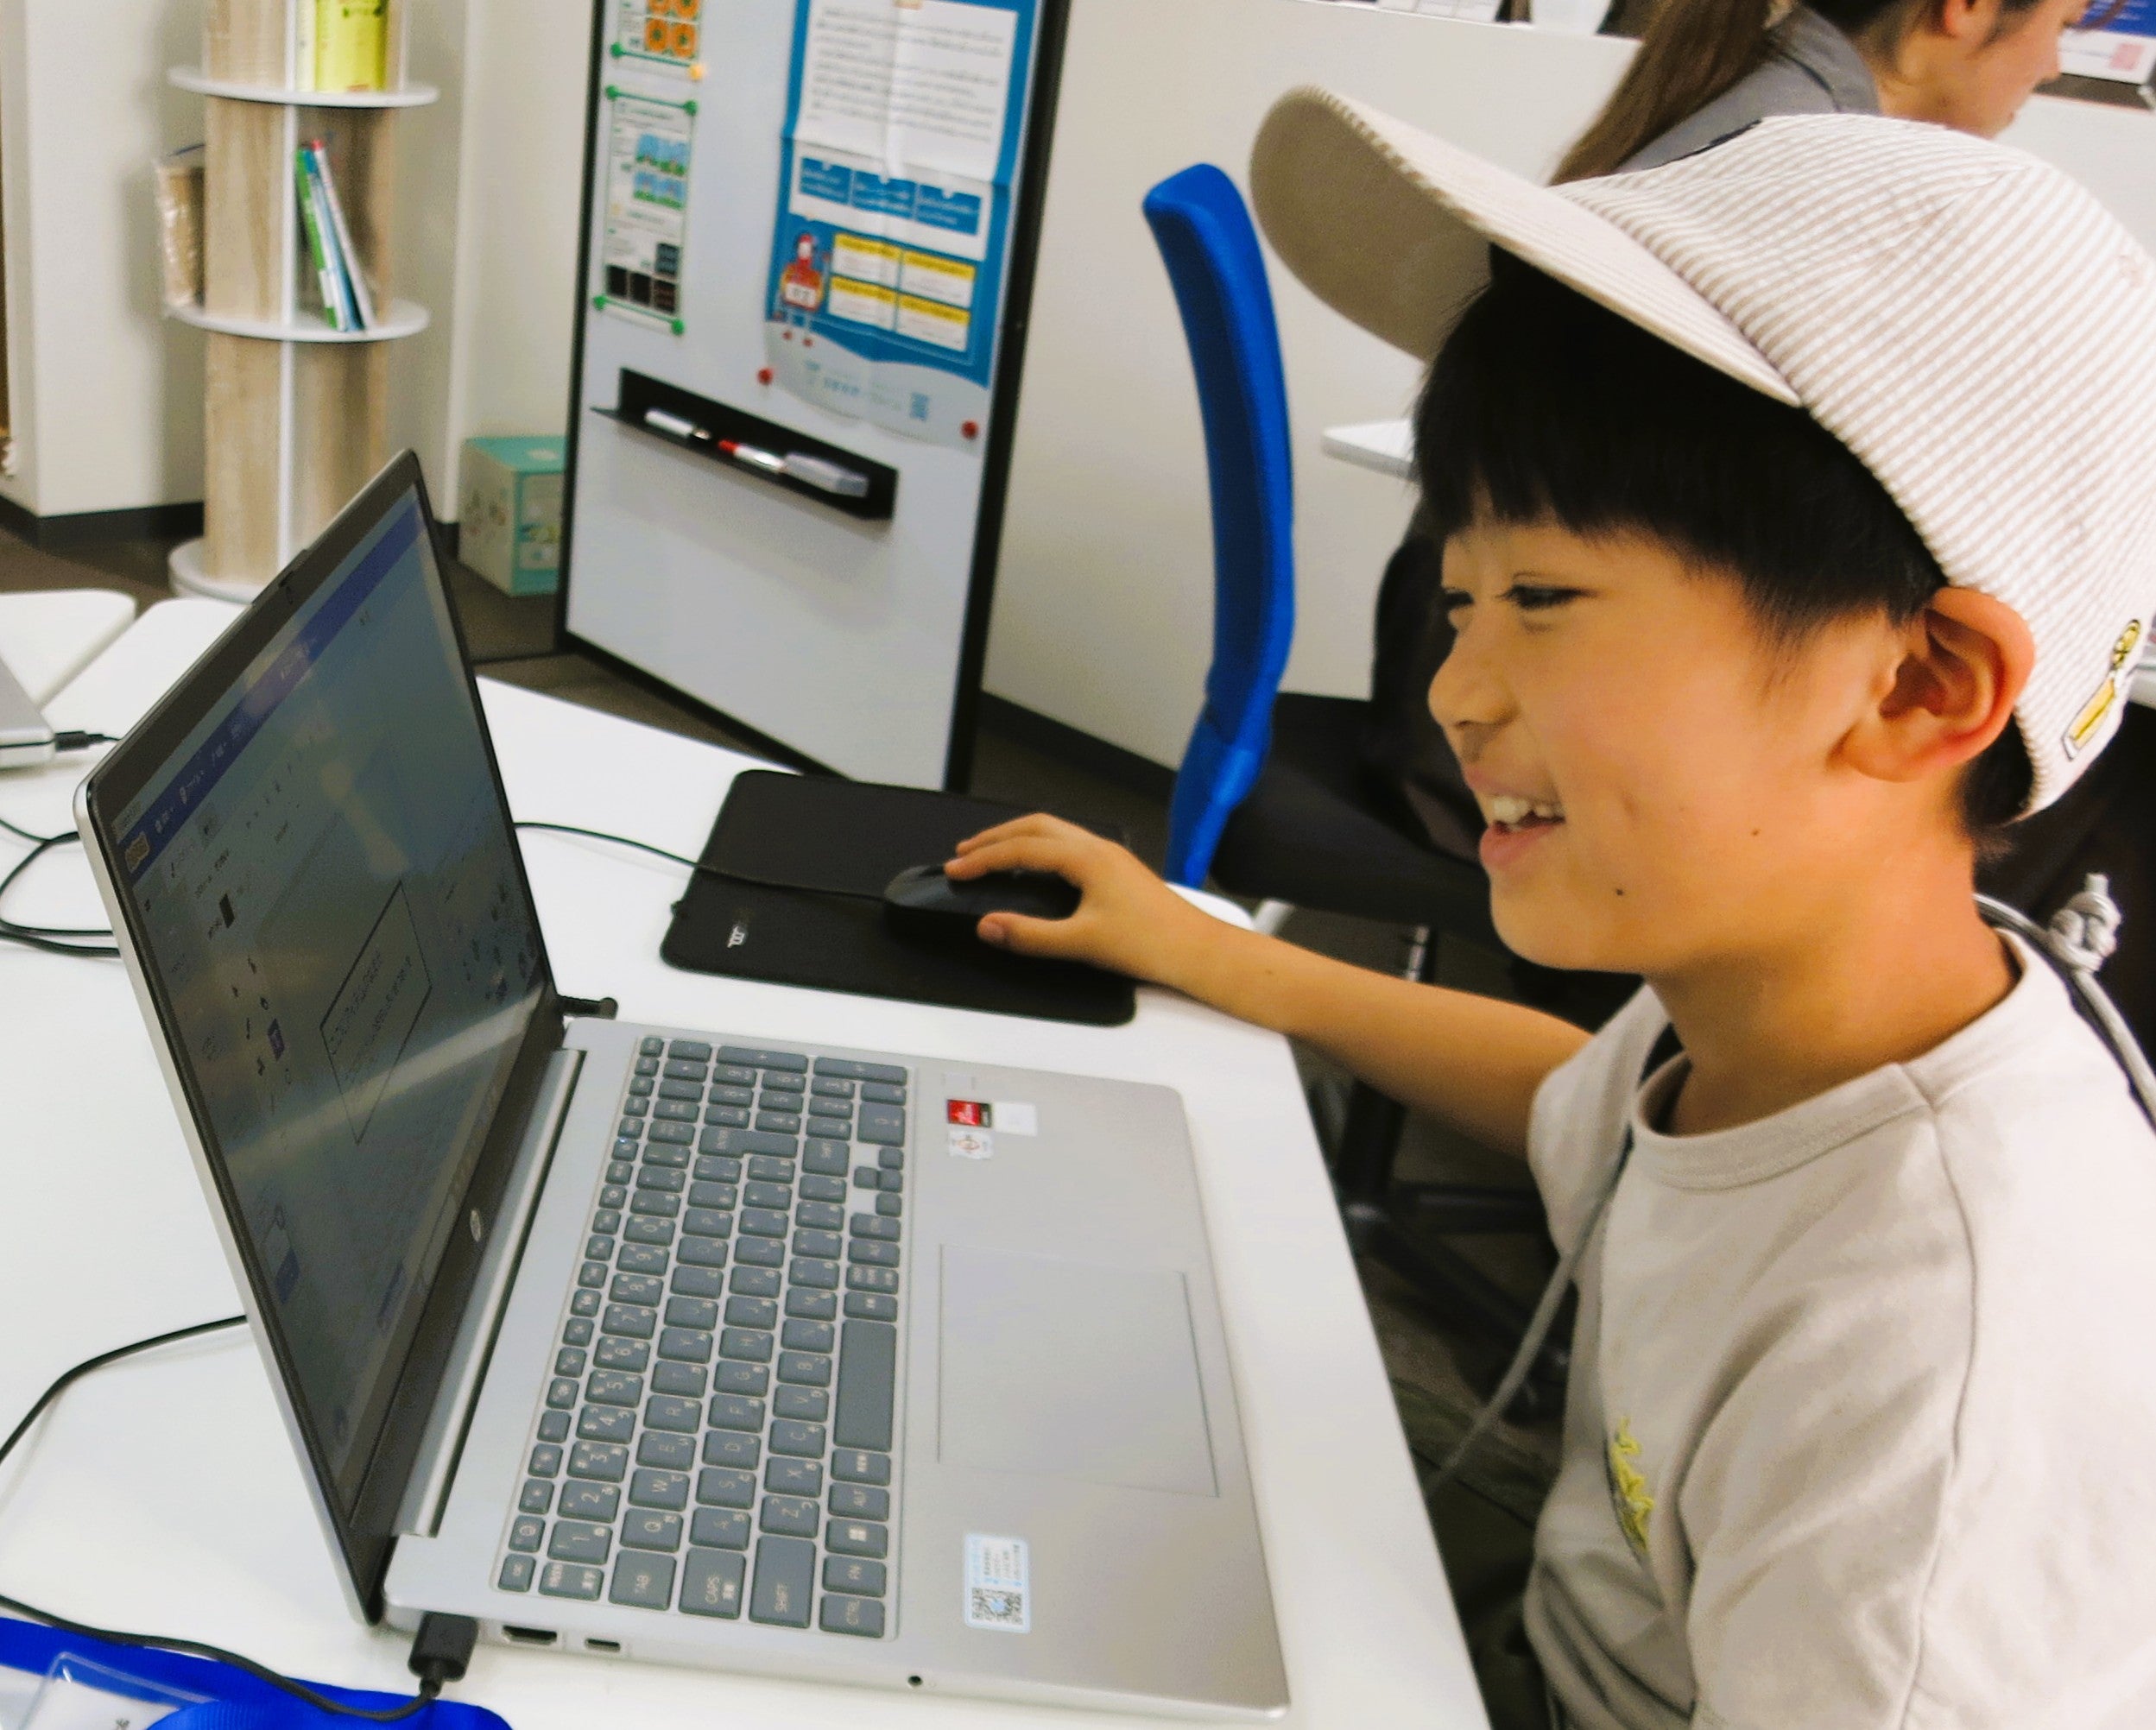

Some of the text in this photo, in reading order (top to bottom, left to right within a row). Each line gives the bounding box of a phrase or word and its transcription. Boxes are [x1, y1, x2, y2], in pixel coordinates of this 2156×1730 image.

[629, 1283, 645, 1293] 8
[614, 1347, 633, 1357] 6
[796, 1361, 814, 1372] B
[605, 1380, 623, 1392] 5
[793, 1395, 810, 1405] V
[664, 1406, 681, 1417] R
[598, 1414, 616, 1427] 4
[789, 1430, 807, 1441] C
[657, 1444, 677, 1455] E
[723, 1442, 741, 1453] D
[590, 1452, 610, 1463] 3
[786, 1468, 803, 1479] X
[651, 1480, 669, 1493] W
[718, 1479, 736, 1489] S
[580, 1491, 600, 1504] 2
[852, 1489, 867, 1508] ALT
[781, 1506, 800, 1518] Z
[643, 1519, 663, 1533] Q
[634, 1573, 650, 1596] TAB
[704, 1574, 720, 1605] CAPS
[845, 1598, 862, 1627] CTRL
